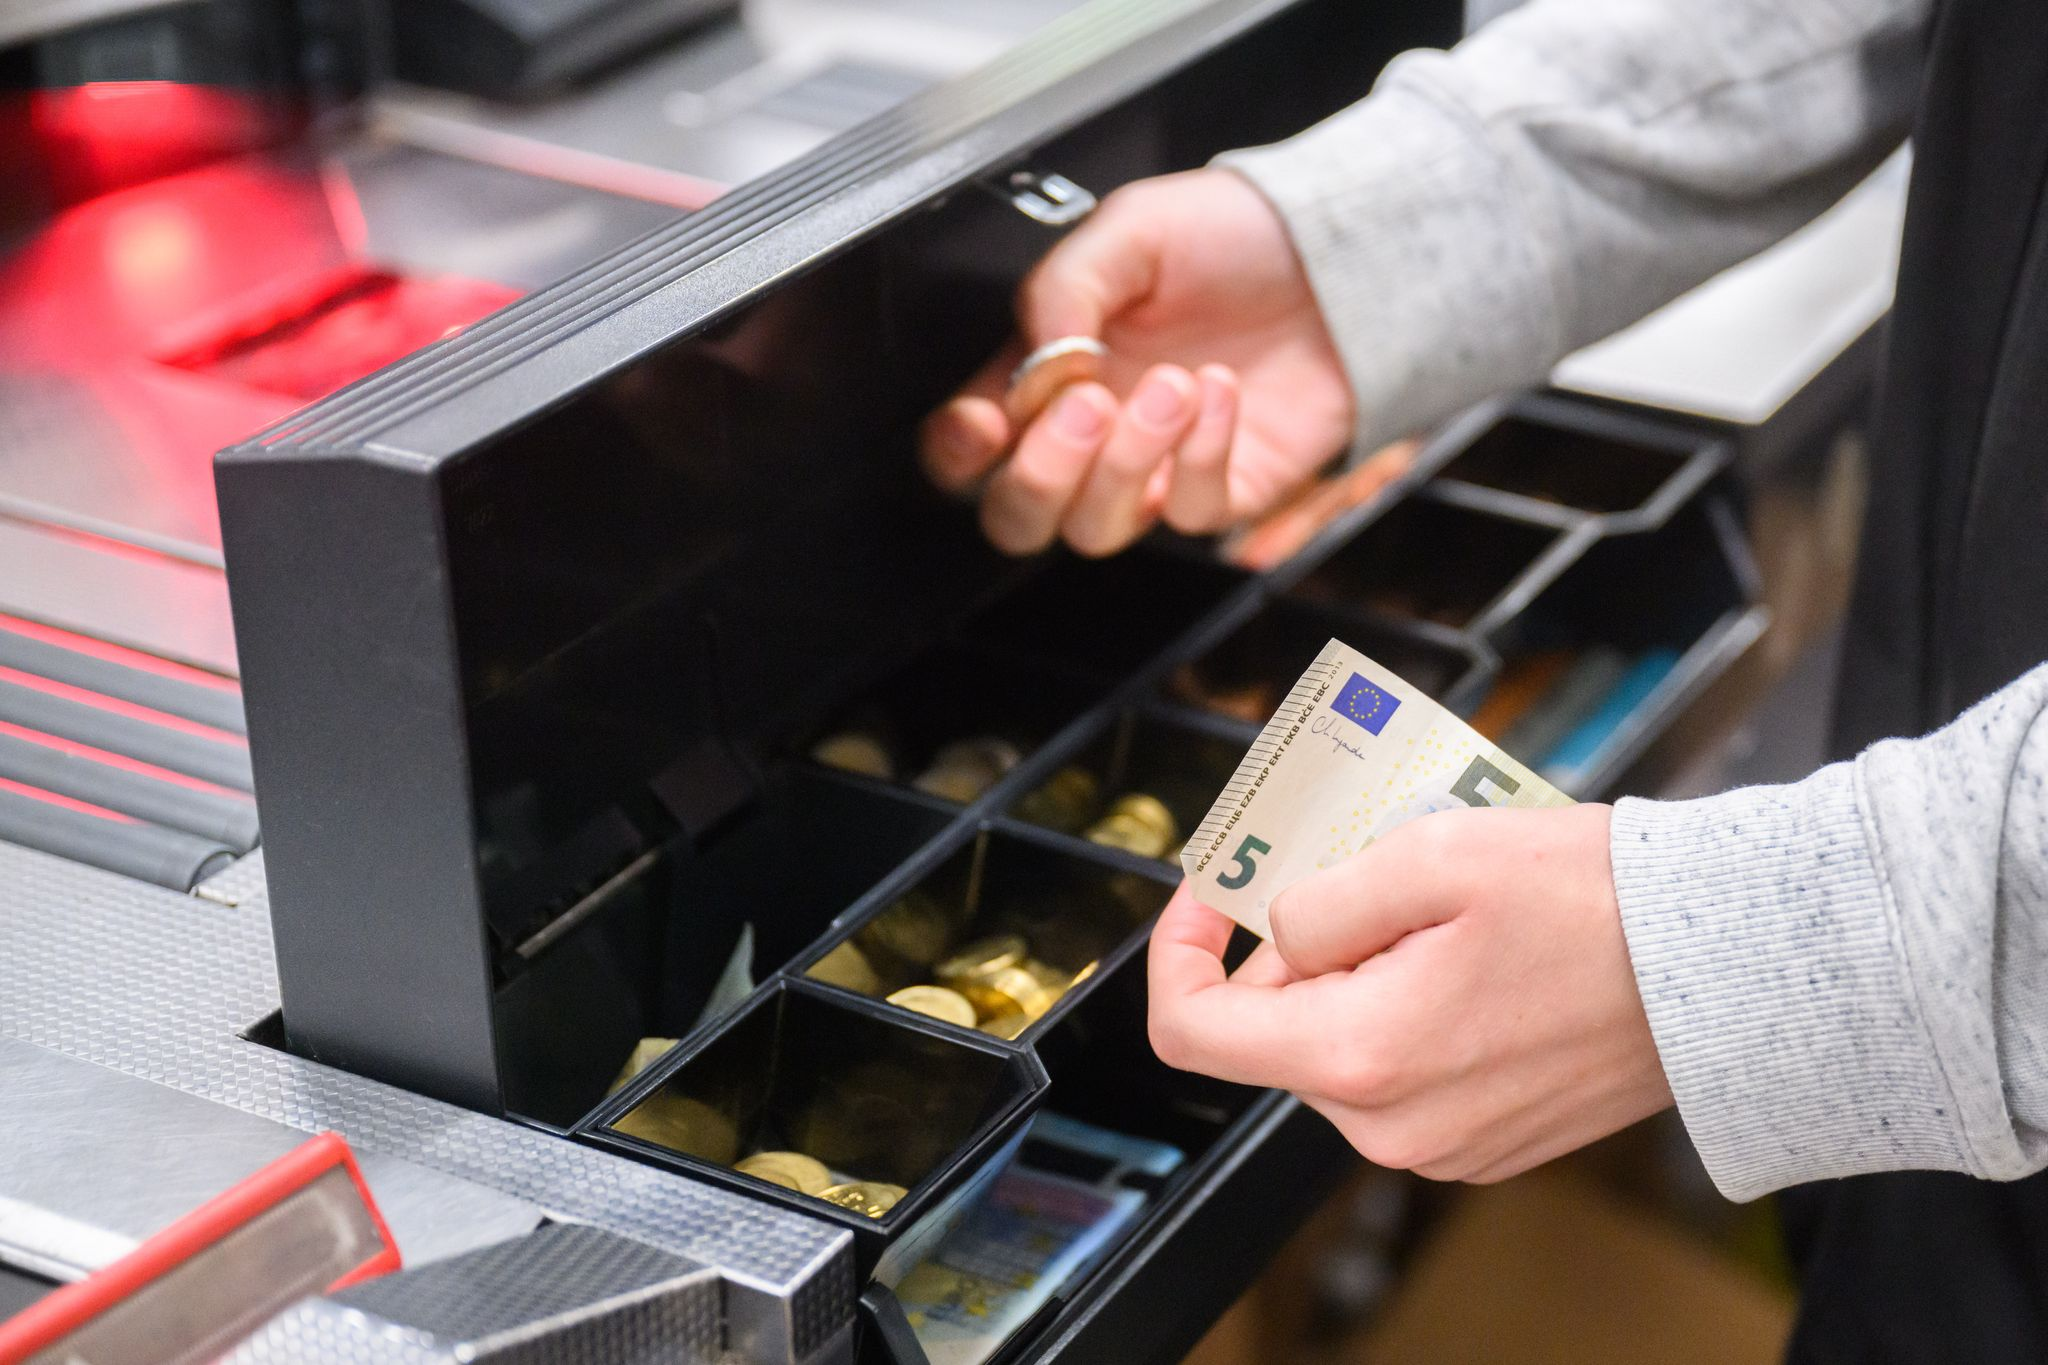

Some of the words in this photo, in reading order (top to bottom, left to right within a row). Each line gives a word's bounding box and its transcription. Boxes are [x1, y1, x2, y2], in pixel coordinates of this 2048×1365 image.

[1196, 852, 1213, 872] BCE
[1210, 832, 1227, 852] ECB
[1240, 788, 1257, 808] EZB
[1254, 767, 1270, 787] EKP
[1283, 725, 1300, 745] EKB
[1312, 682, 1330, 703] EBC
[1328, 661, 1343, 679] 2013
[1216, 834, 1272, 890] 5
